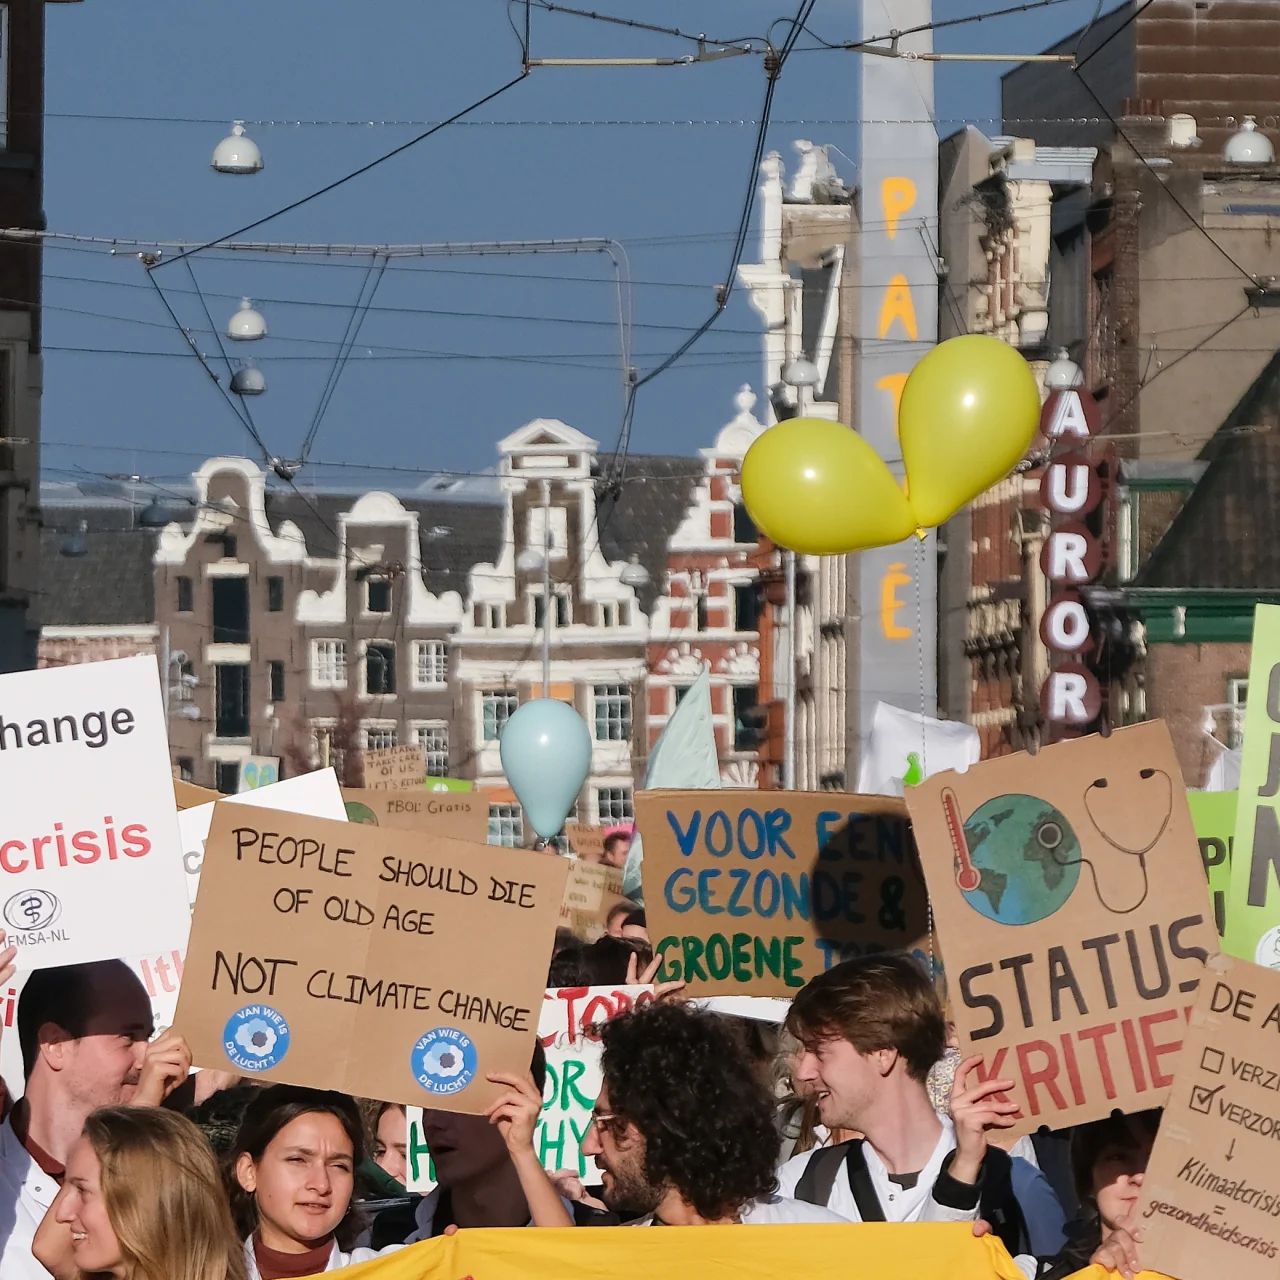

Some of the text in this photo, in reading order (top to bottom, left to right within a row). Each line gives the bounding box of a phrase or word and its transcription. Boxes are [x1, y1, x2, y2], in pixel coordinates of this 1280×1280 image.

[876, 175, 918, 641] PATÉ
[1048, 389, 1091, 721] AUROR
[427, 800, 472, 815] Gratis
[665, 806, 797, 860] VOOR
[815, 811, 904, 865] EEN
[231, 827, 357, 878] PEOPLE
[378, 855, 479, 897] SHOULD
[487, 875, 537, 909] DIE
[663, 866, 867, 925] GEZONDE
[3, 928, 71, 949] IFMSA-NL
[273, 886, 435, 936] OF OLD AGE
[654, 931, 806, 989] GROENE
[958, 913, 1210, 1042] STATUS
[211, 949, 298, 996] NOT
[305, 968, 432, 1012] CLIMATE
[437, 988, 532, 1033] CHANGE
[1210, 981, 1257, 1023] DE
[225, 1041, 238, 1057] DE
[236, 1006, 288, 1035] VAN WIE IS
[415, 1028, 471, 1051] VAN WIE IS
[418, 1073, 434, 1089] DE
[976, 1005, 1196, 1124] KRITIE
[1142, 1199, 1280, 1260] gezondheidscrisis
